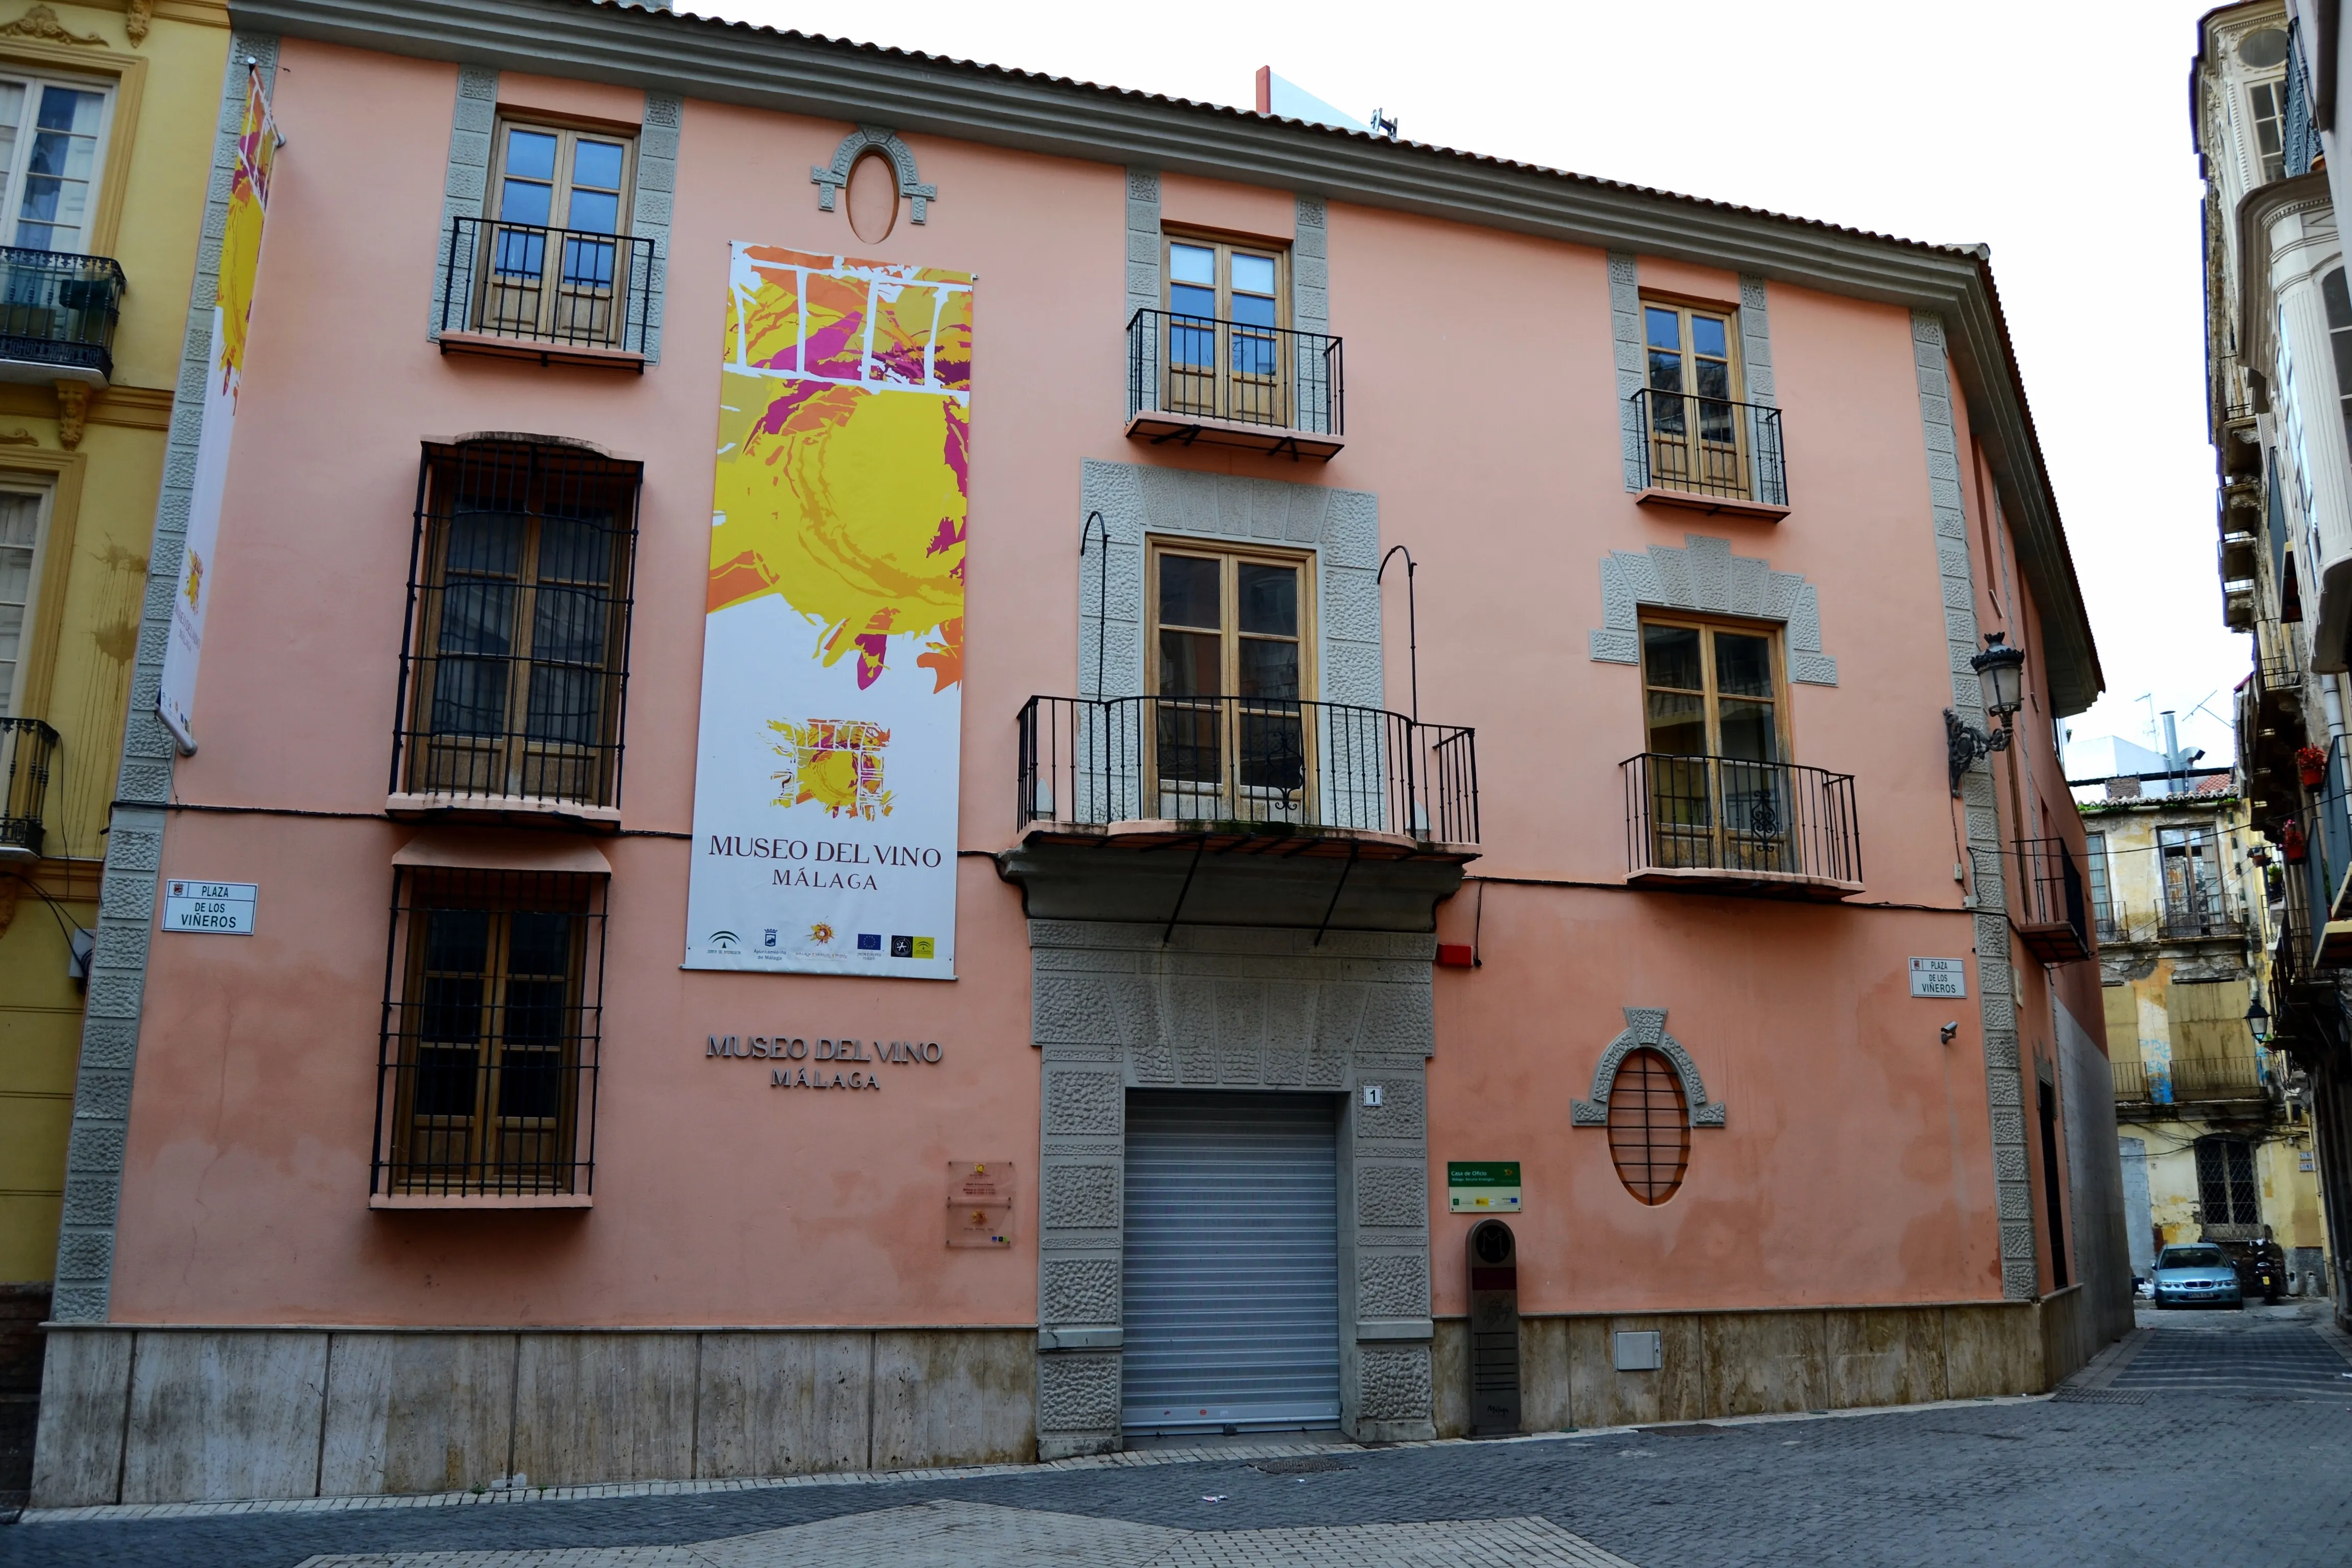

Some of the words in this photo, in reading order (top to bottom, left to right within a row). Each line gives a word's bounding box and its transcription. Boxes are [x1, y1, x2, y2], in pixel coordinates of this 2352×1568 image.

[708, 835, 807, 860] MUSEO
[815, 841, 869, 864] DEL
[873, 844, 941, 868] VINO
[772, 867, 878, 891] MÁLAGA
[202, 886, 229, 898] PLAZA
[194, 902, 206, 912] DE
[209, 902, 225, 913] LOS
[181, 913, 236, 928] VIÑEROS
[1931, 961, 1948, 970] PLAZA
[1922, 982, 1956, 993] VIÑEROS
[706, 1034, 808, 1059] MUSEO
[815, 1038, 871, 1062] DEL
[874, 1041, 943, 1063] VINO
[771, 1066, 880, 1090] MÁLAGA
[1370, 1089, 1376, 1102] 1
